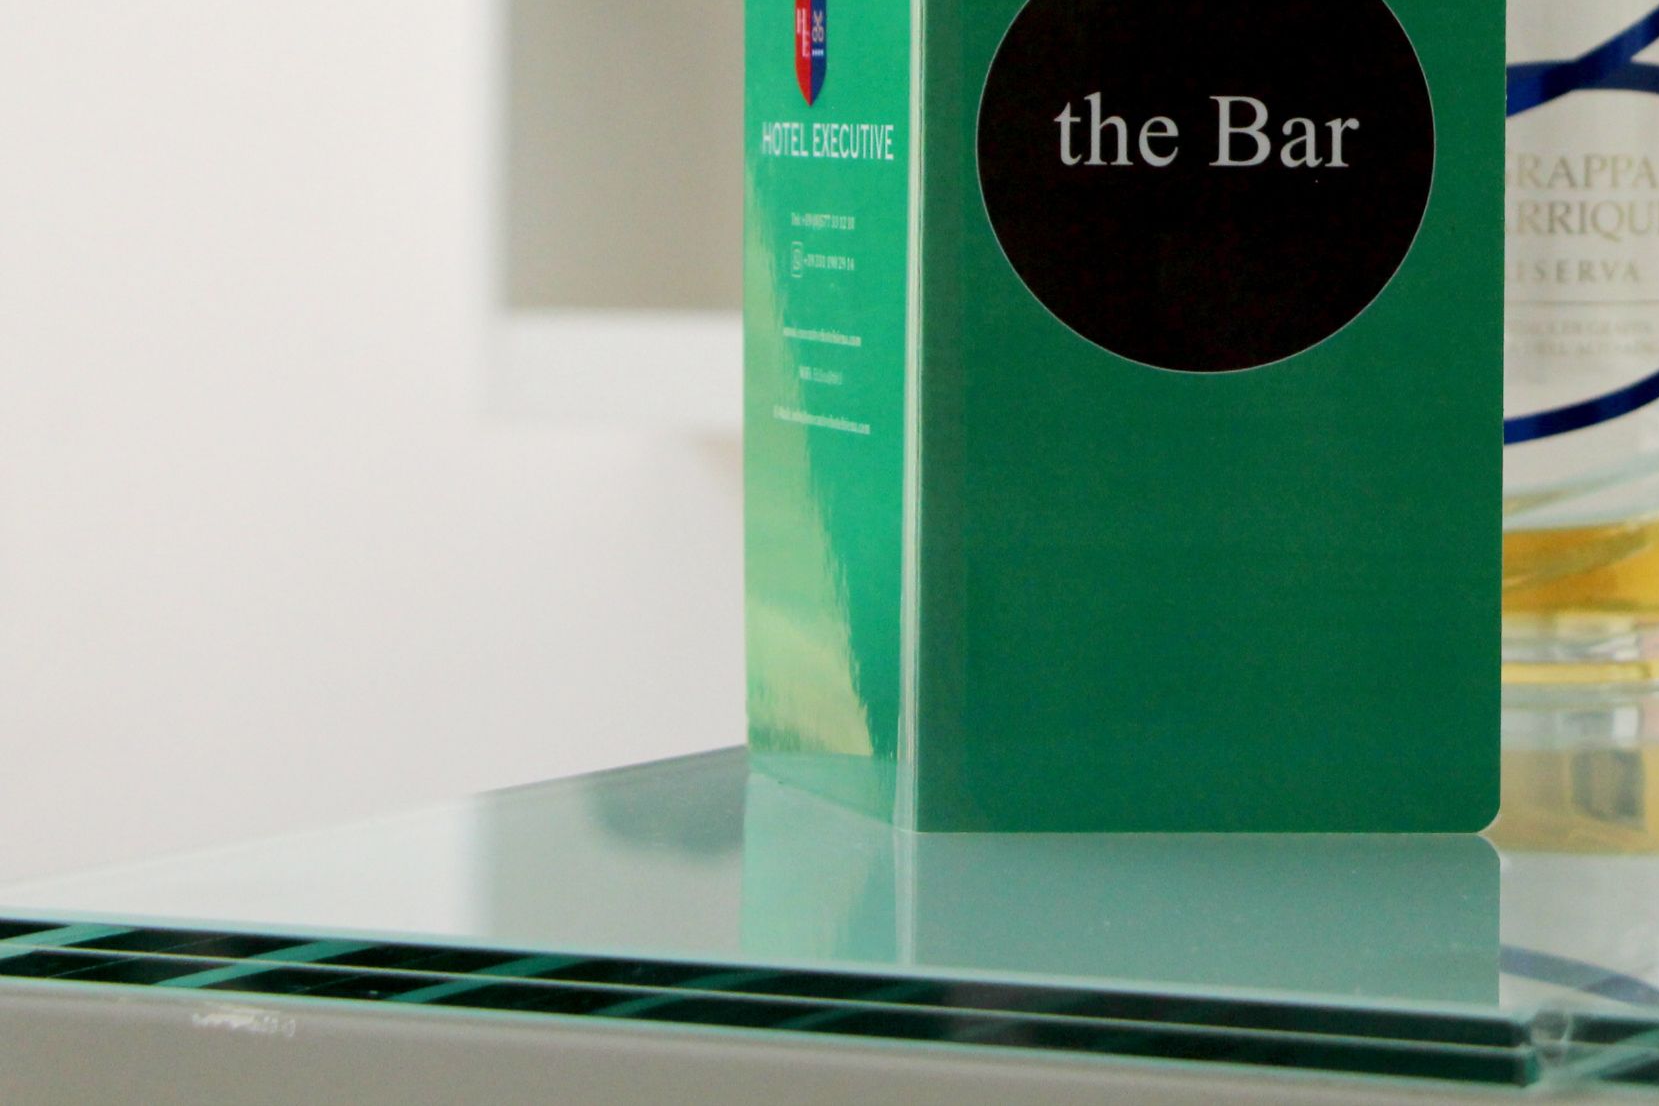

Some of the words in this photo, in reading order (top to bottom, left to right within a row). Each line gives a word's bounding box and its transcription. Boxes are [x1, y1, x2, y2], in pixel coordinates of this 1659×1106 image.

[762, 121, 808, 157] HOTEL
[812, 122, 894, 160] EXECUTIVE
[1054, 91, 1179, 167] the
[1209, 95, 1360, 168] Bar
[1505, 153, 1659, 190] RAPPA
